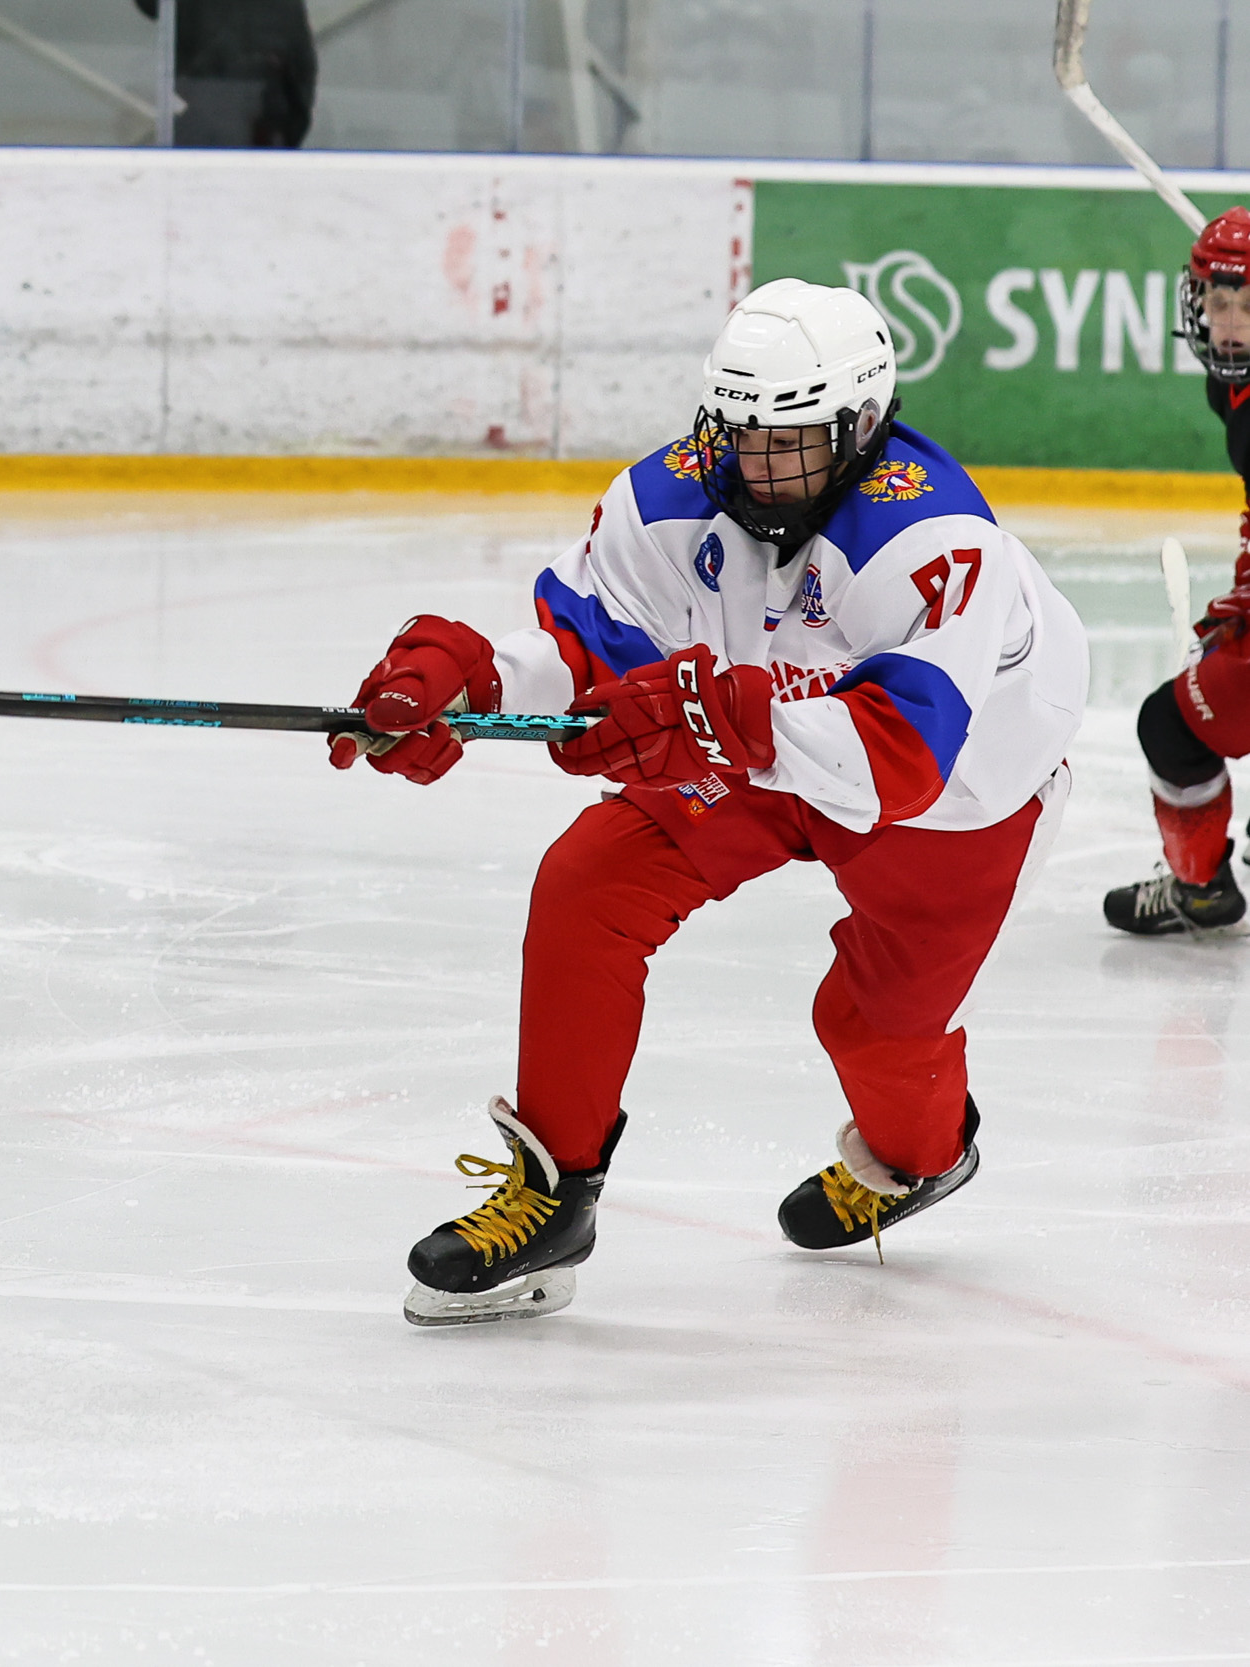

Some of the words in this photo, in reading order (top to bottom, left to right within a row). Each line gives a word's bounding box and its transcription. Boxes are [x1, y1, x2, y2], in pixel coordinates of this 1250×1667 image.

[857, 361, 888, 384] CCM
[714, 386, 760, 403] CCM
[380, 691, 419, 707] CCM
[677, 659, 733, 767] CCM
